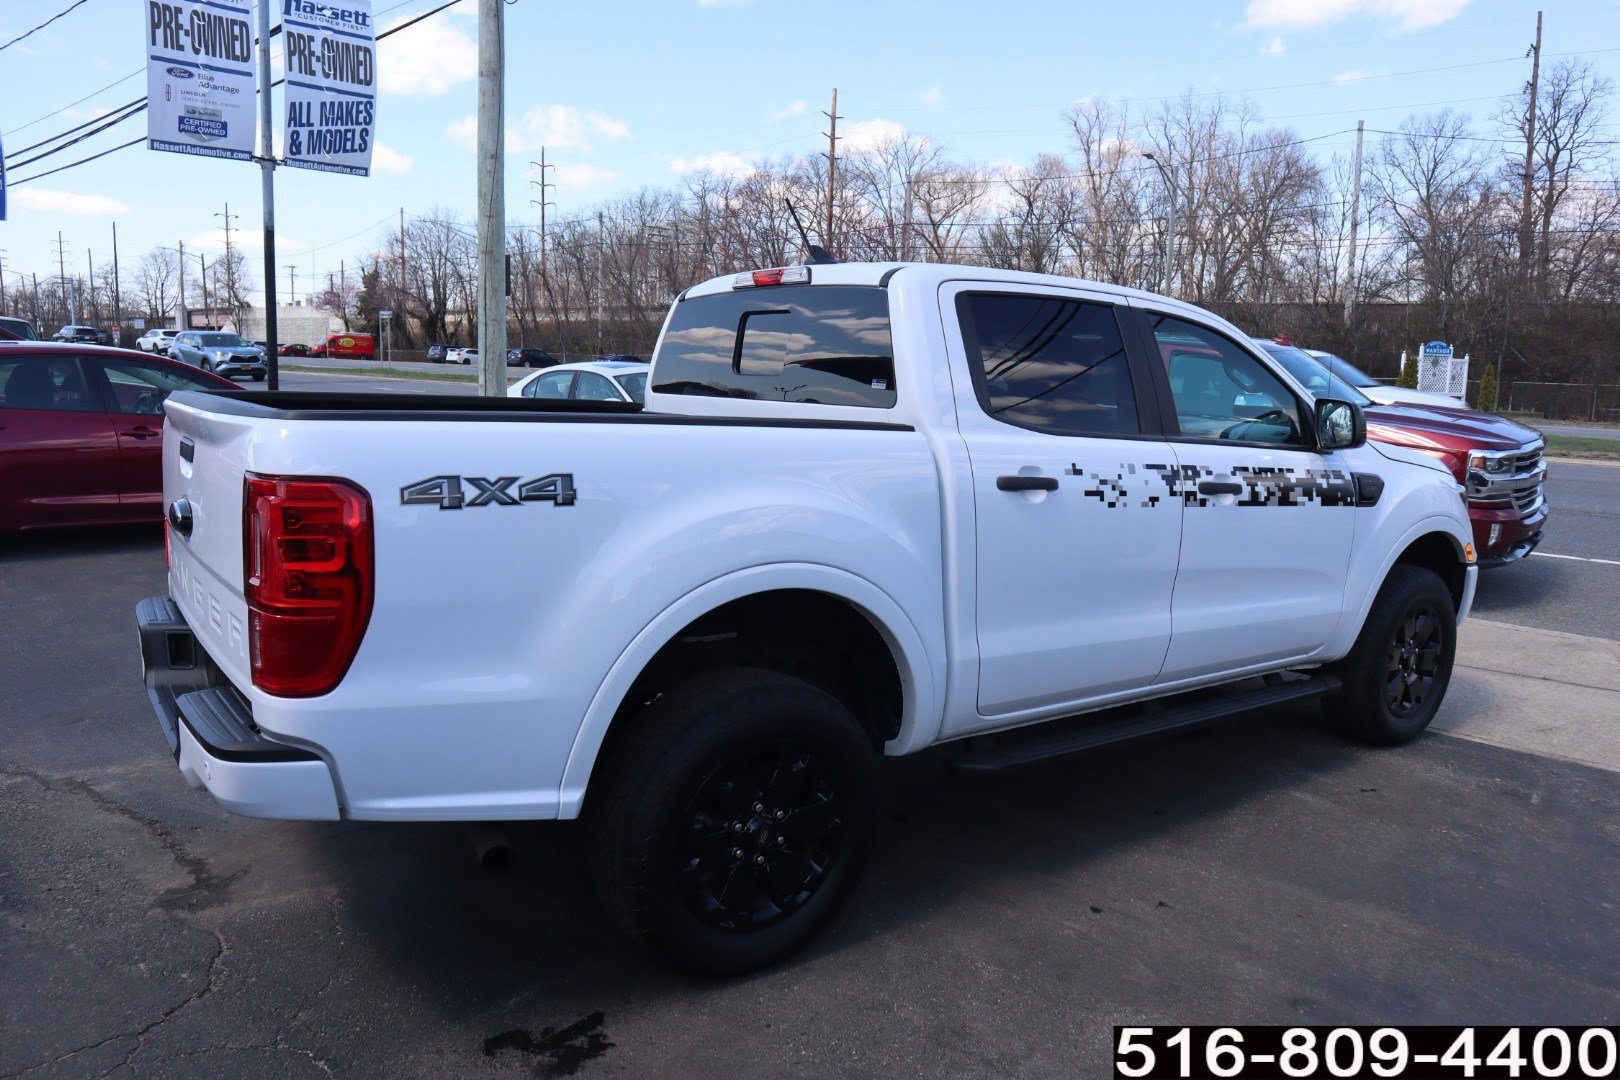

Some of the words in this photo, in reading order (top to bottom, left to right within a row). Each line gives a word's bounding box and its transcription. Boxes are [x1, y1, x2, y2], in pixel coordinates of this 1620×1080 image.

[149, 1, 251, 63] PRE-OWNED
[286, 30, 373, 87] PRE-OWNED
[197, 73, 215, 82] Blue
[180, 89, 206, 97] LINCOLN
[198, 81, 240, 95] Advantage
[287, 101, 314, 128] ALL
[320, 100, 374, 127] MAKES
[180, 124, 226, 136] PRE-OWNED
[184, 117, 222, 129] CERTIFIED
[153, 141, 250, 159] HassettAutomotive.com
[289, 129, 302, 156] &
[306, 127, 369, 155] MODELS
[286, 159, 366, 176] HassettAutomotive.com
